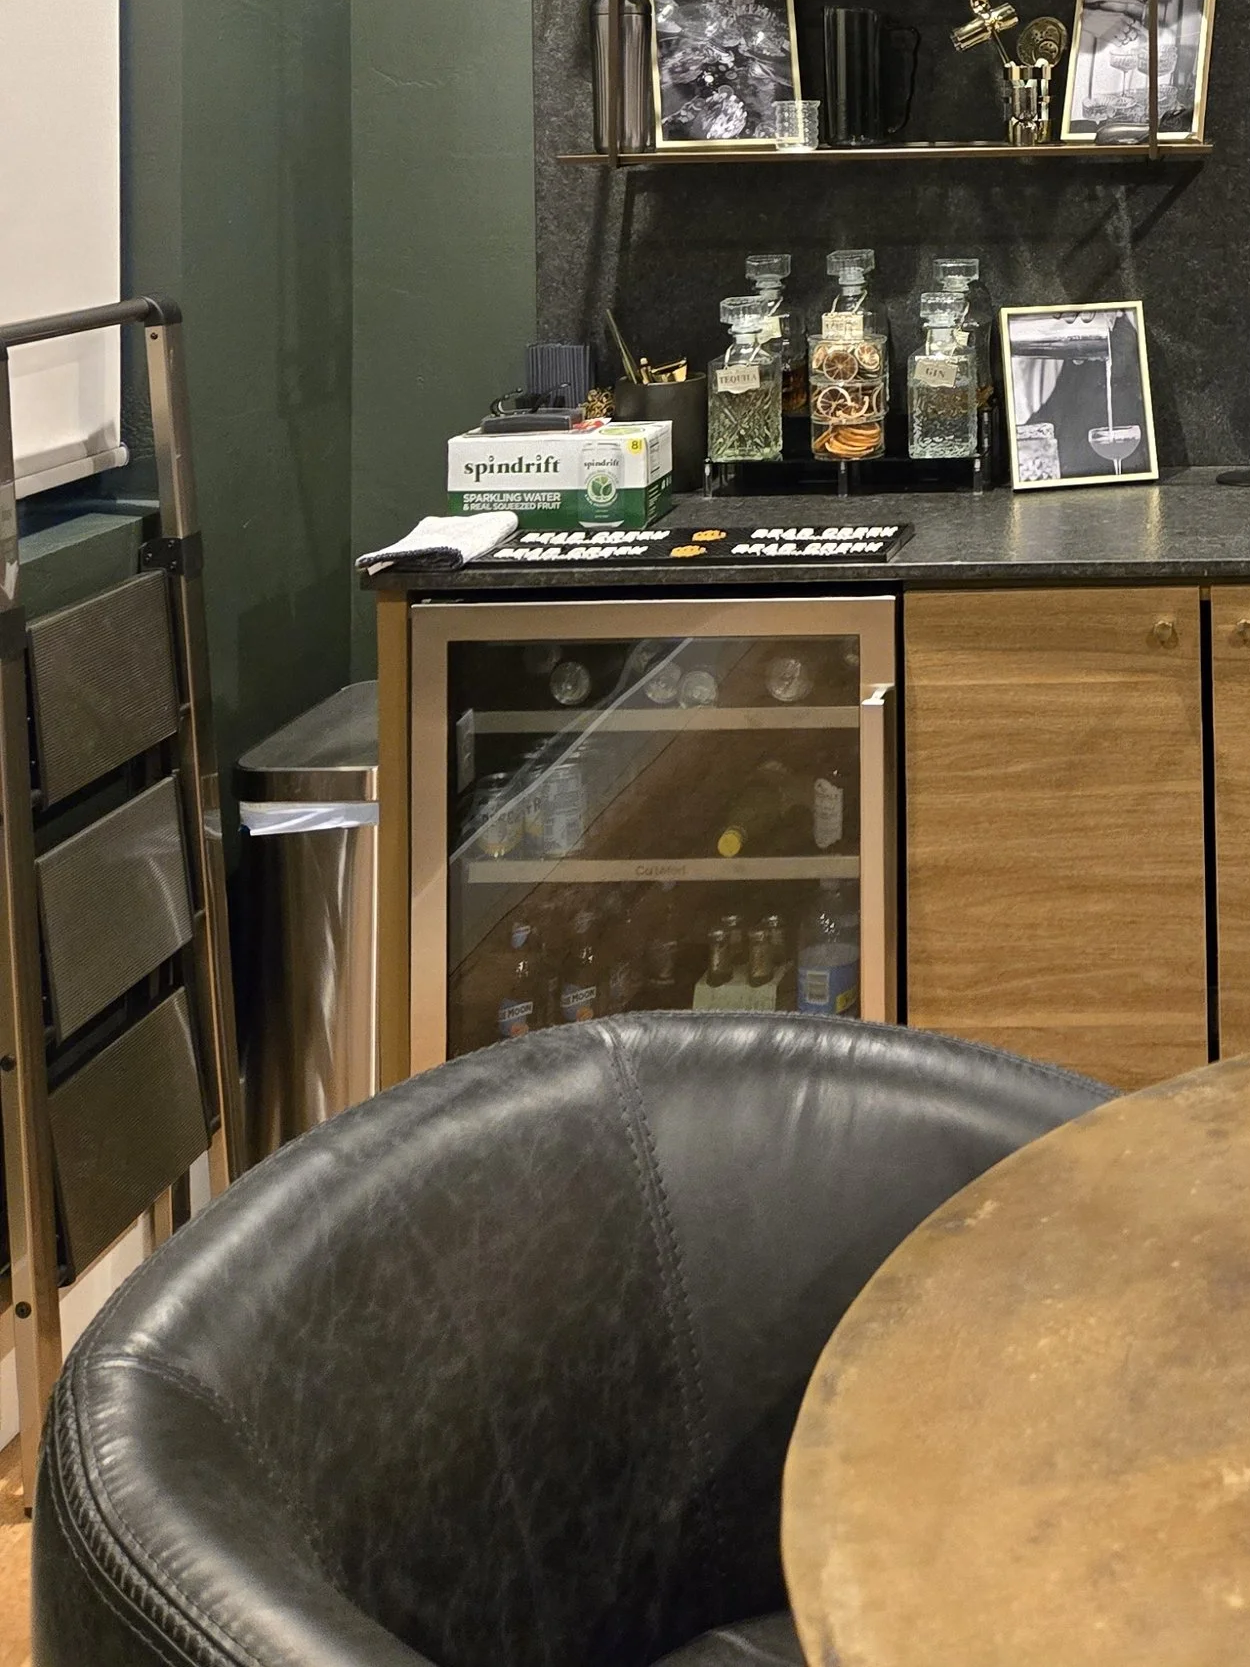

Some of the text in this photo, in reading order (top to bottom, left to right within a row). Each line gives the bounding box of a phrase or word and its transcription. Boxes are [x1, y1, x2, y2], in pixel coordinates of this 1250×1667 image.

[718, 373, 757, 384] TEQUILA
[925, 367, 946, 379] GIN
[463, 454, 561, 483] spindrift
[583, 456, 620, 469] spindrift
[463, 491, 561, 503] SPARKLING WATER
[470, 501, 491, 511] REAL
[492, 501, 536, 510] SQUEEZED
[536, 500, 561, 509] FRUIT
[569, 988, 596, 1003] MOON
[507, 1003, 533, 1017] MOON
